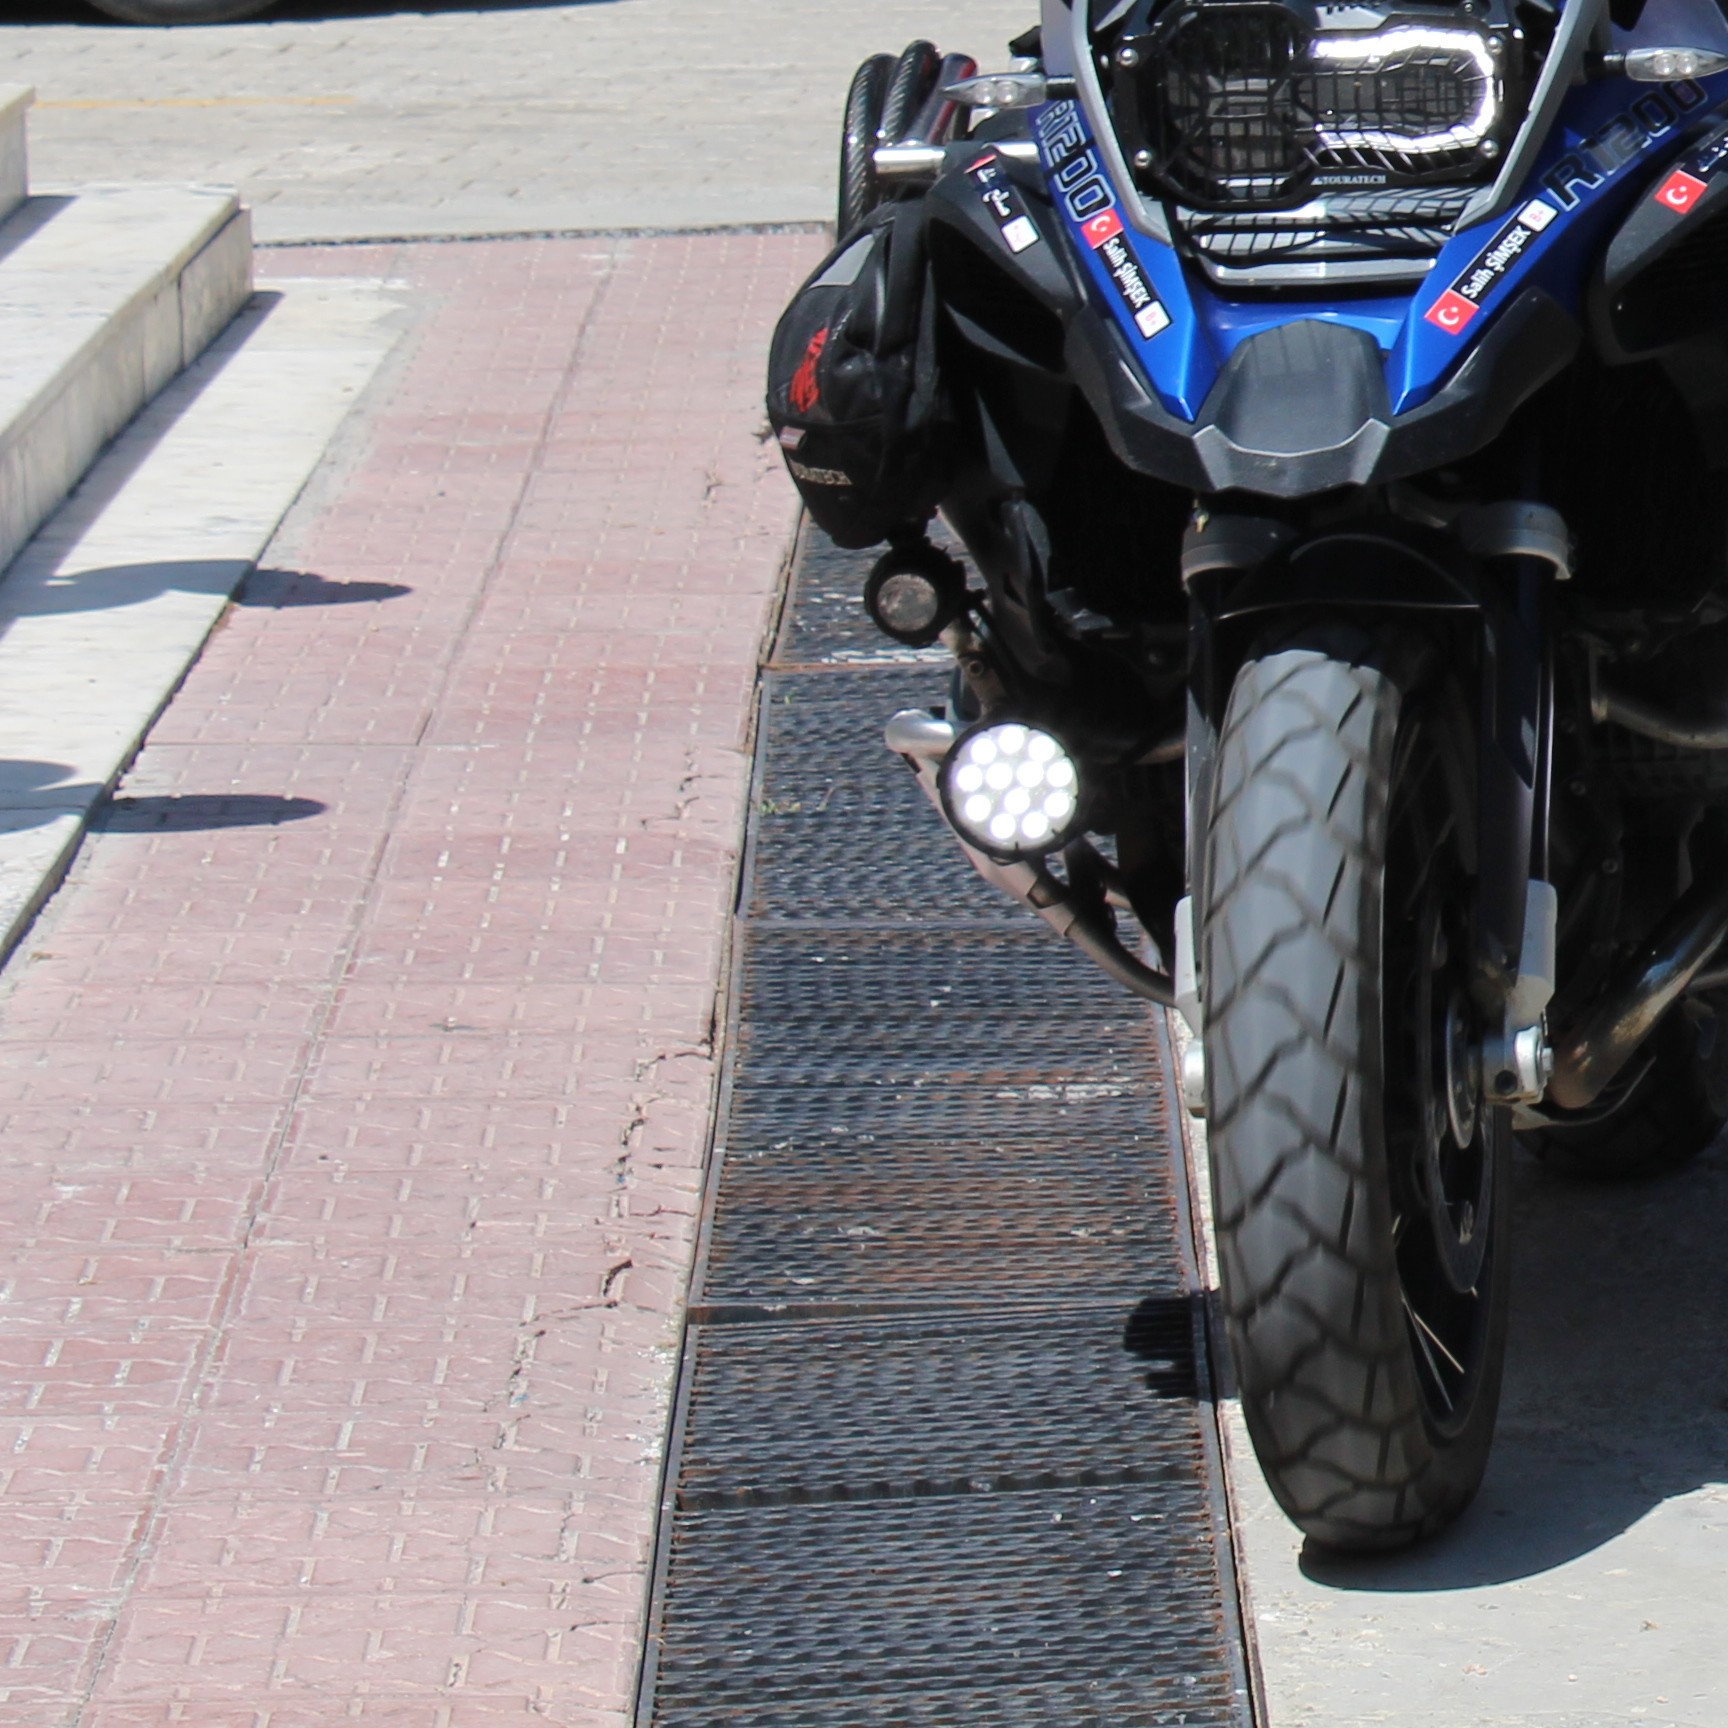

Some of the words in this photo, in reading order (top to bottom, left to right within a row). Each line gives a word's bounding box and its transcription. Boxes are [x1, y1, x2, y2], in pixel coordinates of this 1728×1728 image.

[1034, 99, 1117, 223] R1200
[1323, 174, 1387, 185] TOURATECH
[1539, 76, 1709, 213] R1200
[1461, 267, 1495, 300] Salih
